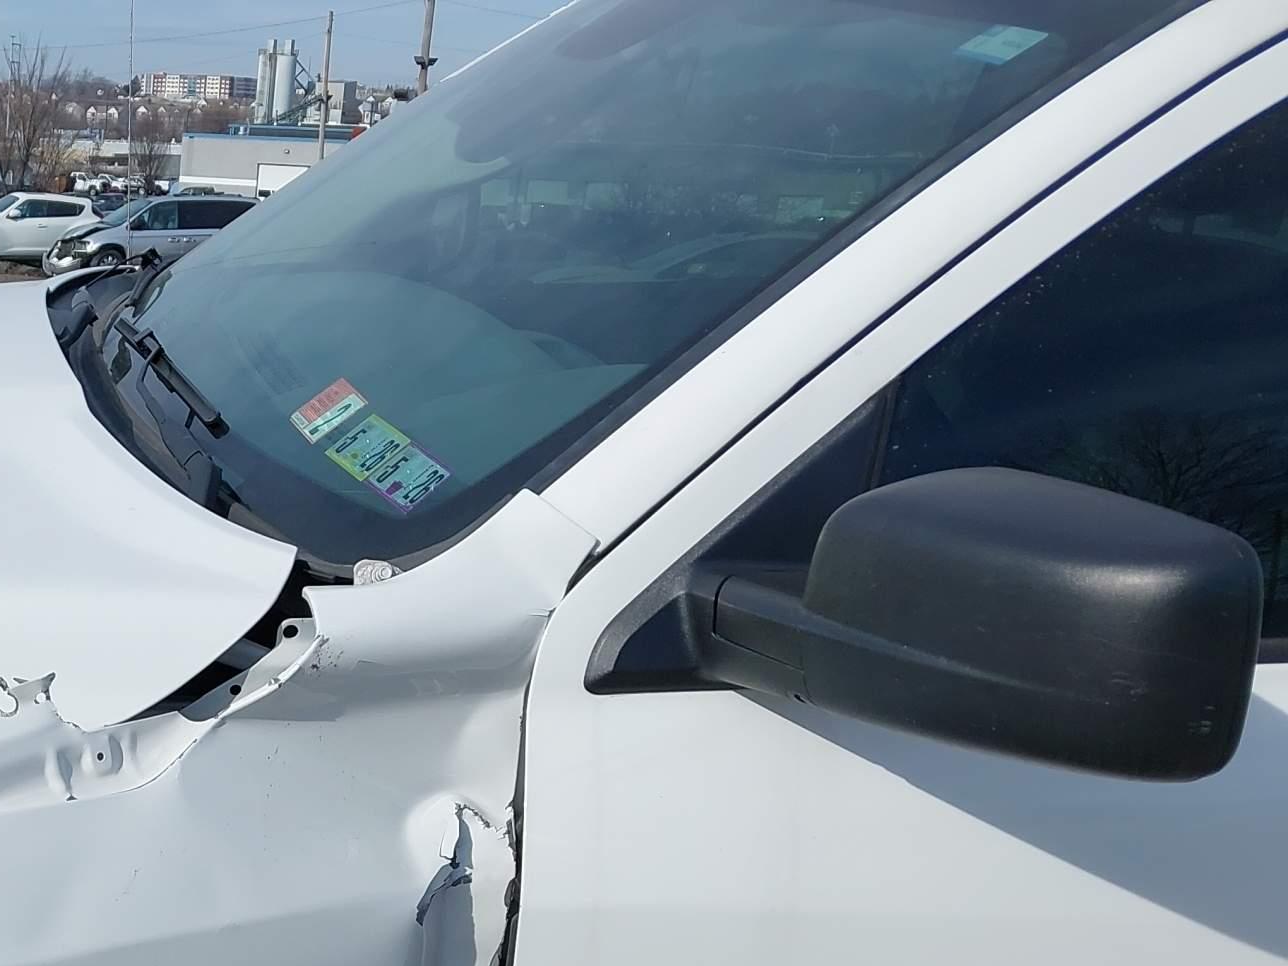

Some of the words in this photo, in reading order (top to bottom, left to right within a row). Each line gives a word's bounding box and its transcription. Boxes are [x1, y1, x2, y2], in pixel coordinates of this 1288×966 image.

[335, 428, 367, 454] 5
[360, 439, 400, 472] 26
[376, 456, 409, 483] 5
[402, 469, 445, 504] 26
